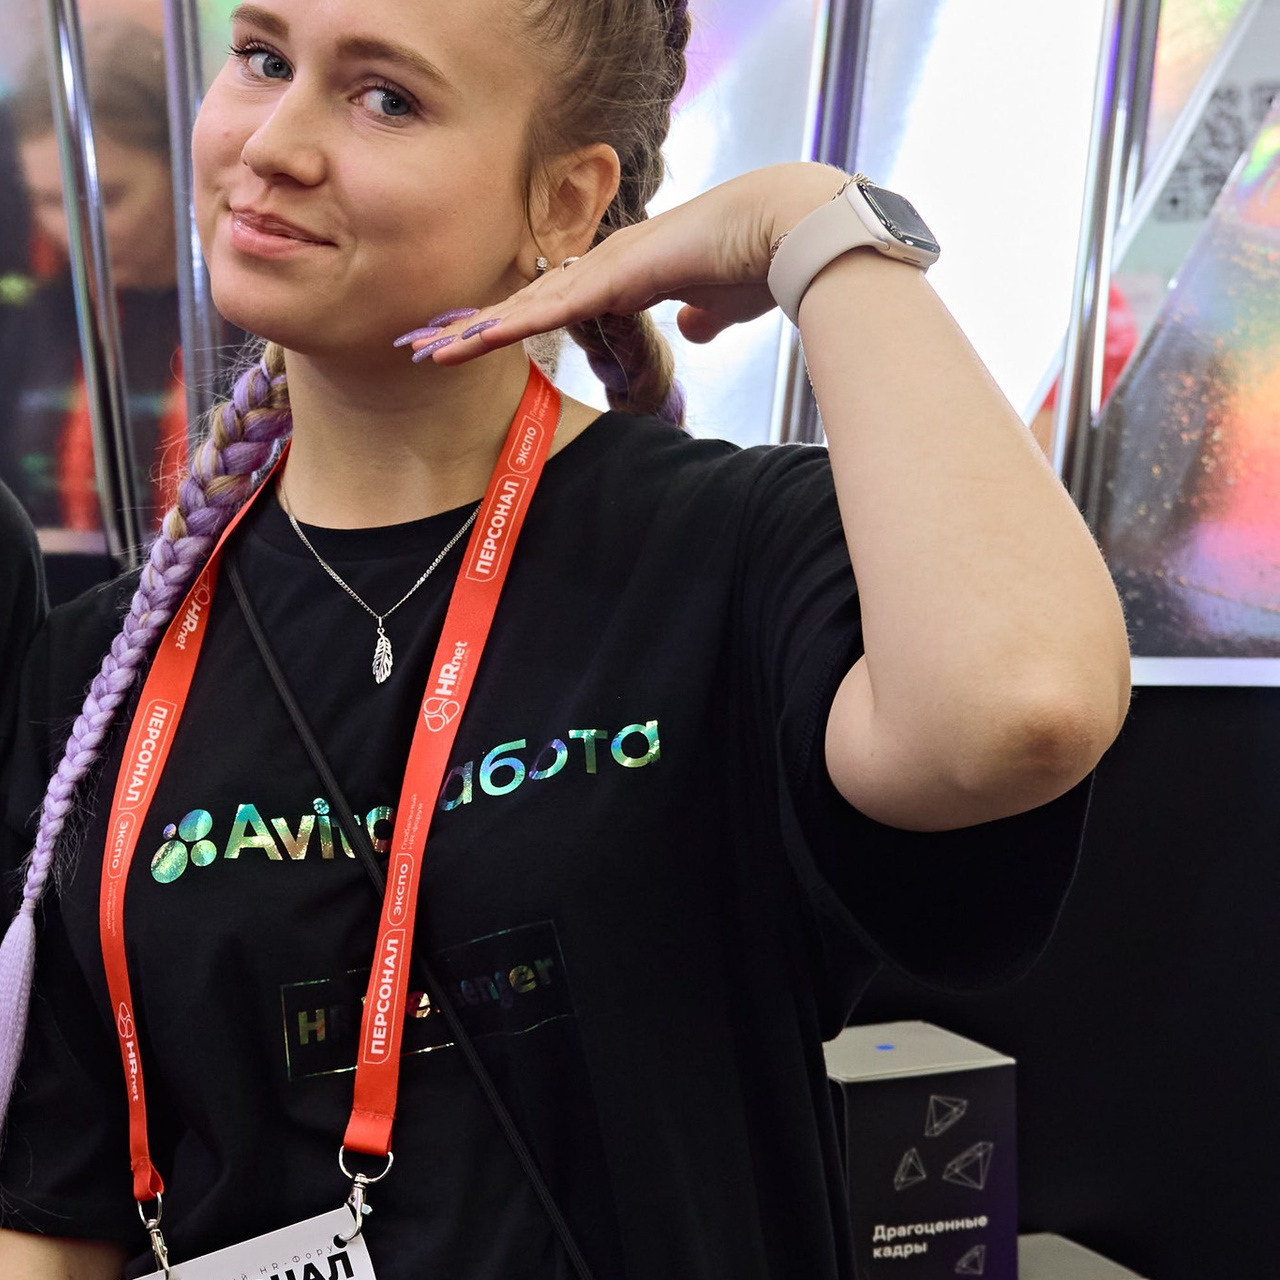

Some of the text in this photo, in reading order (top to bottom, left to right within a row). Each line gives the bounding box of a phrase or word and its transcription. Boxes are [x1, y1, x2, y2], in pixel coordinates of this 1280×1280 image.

[514, 426, 537, 467] ЭКСПО
[475, 480, 520, 575] ПЕРСОНАЛ
[175, 600, 202, 650] HRnet
[435, 640, 468, 696] HRnet
[125, 705, 168, 803] ПЕРСОНАЛ
[438, 720, 661, 812] абота
[111, 821, 130, 869] ЭКСПО
[393, 863, 409, 916] ЭКСПО
[371, 938, 399, 1055] ПЕРСОНАЛ
[125, 1040, 139, 1102] HRnet
[872, 1215, 988, 1242] Драгоценные
[873, 1239, 928, 1259] кадры
[260, 1243, 334, 1277] HR-Фору
